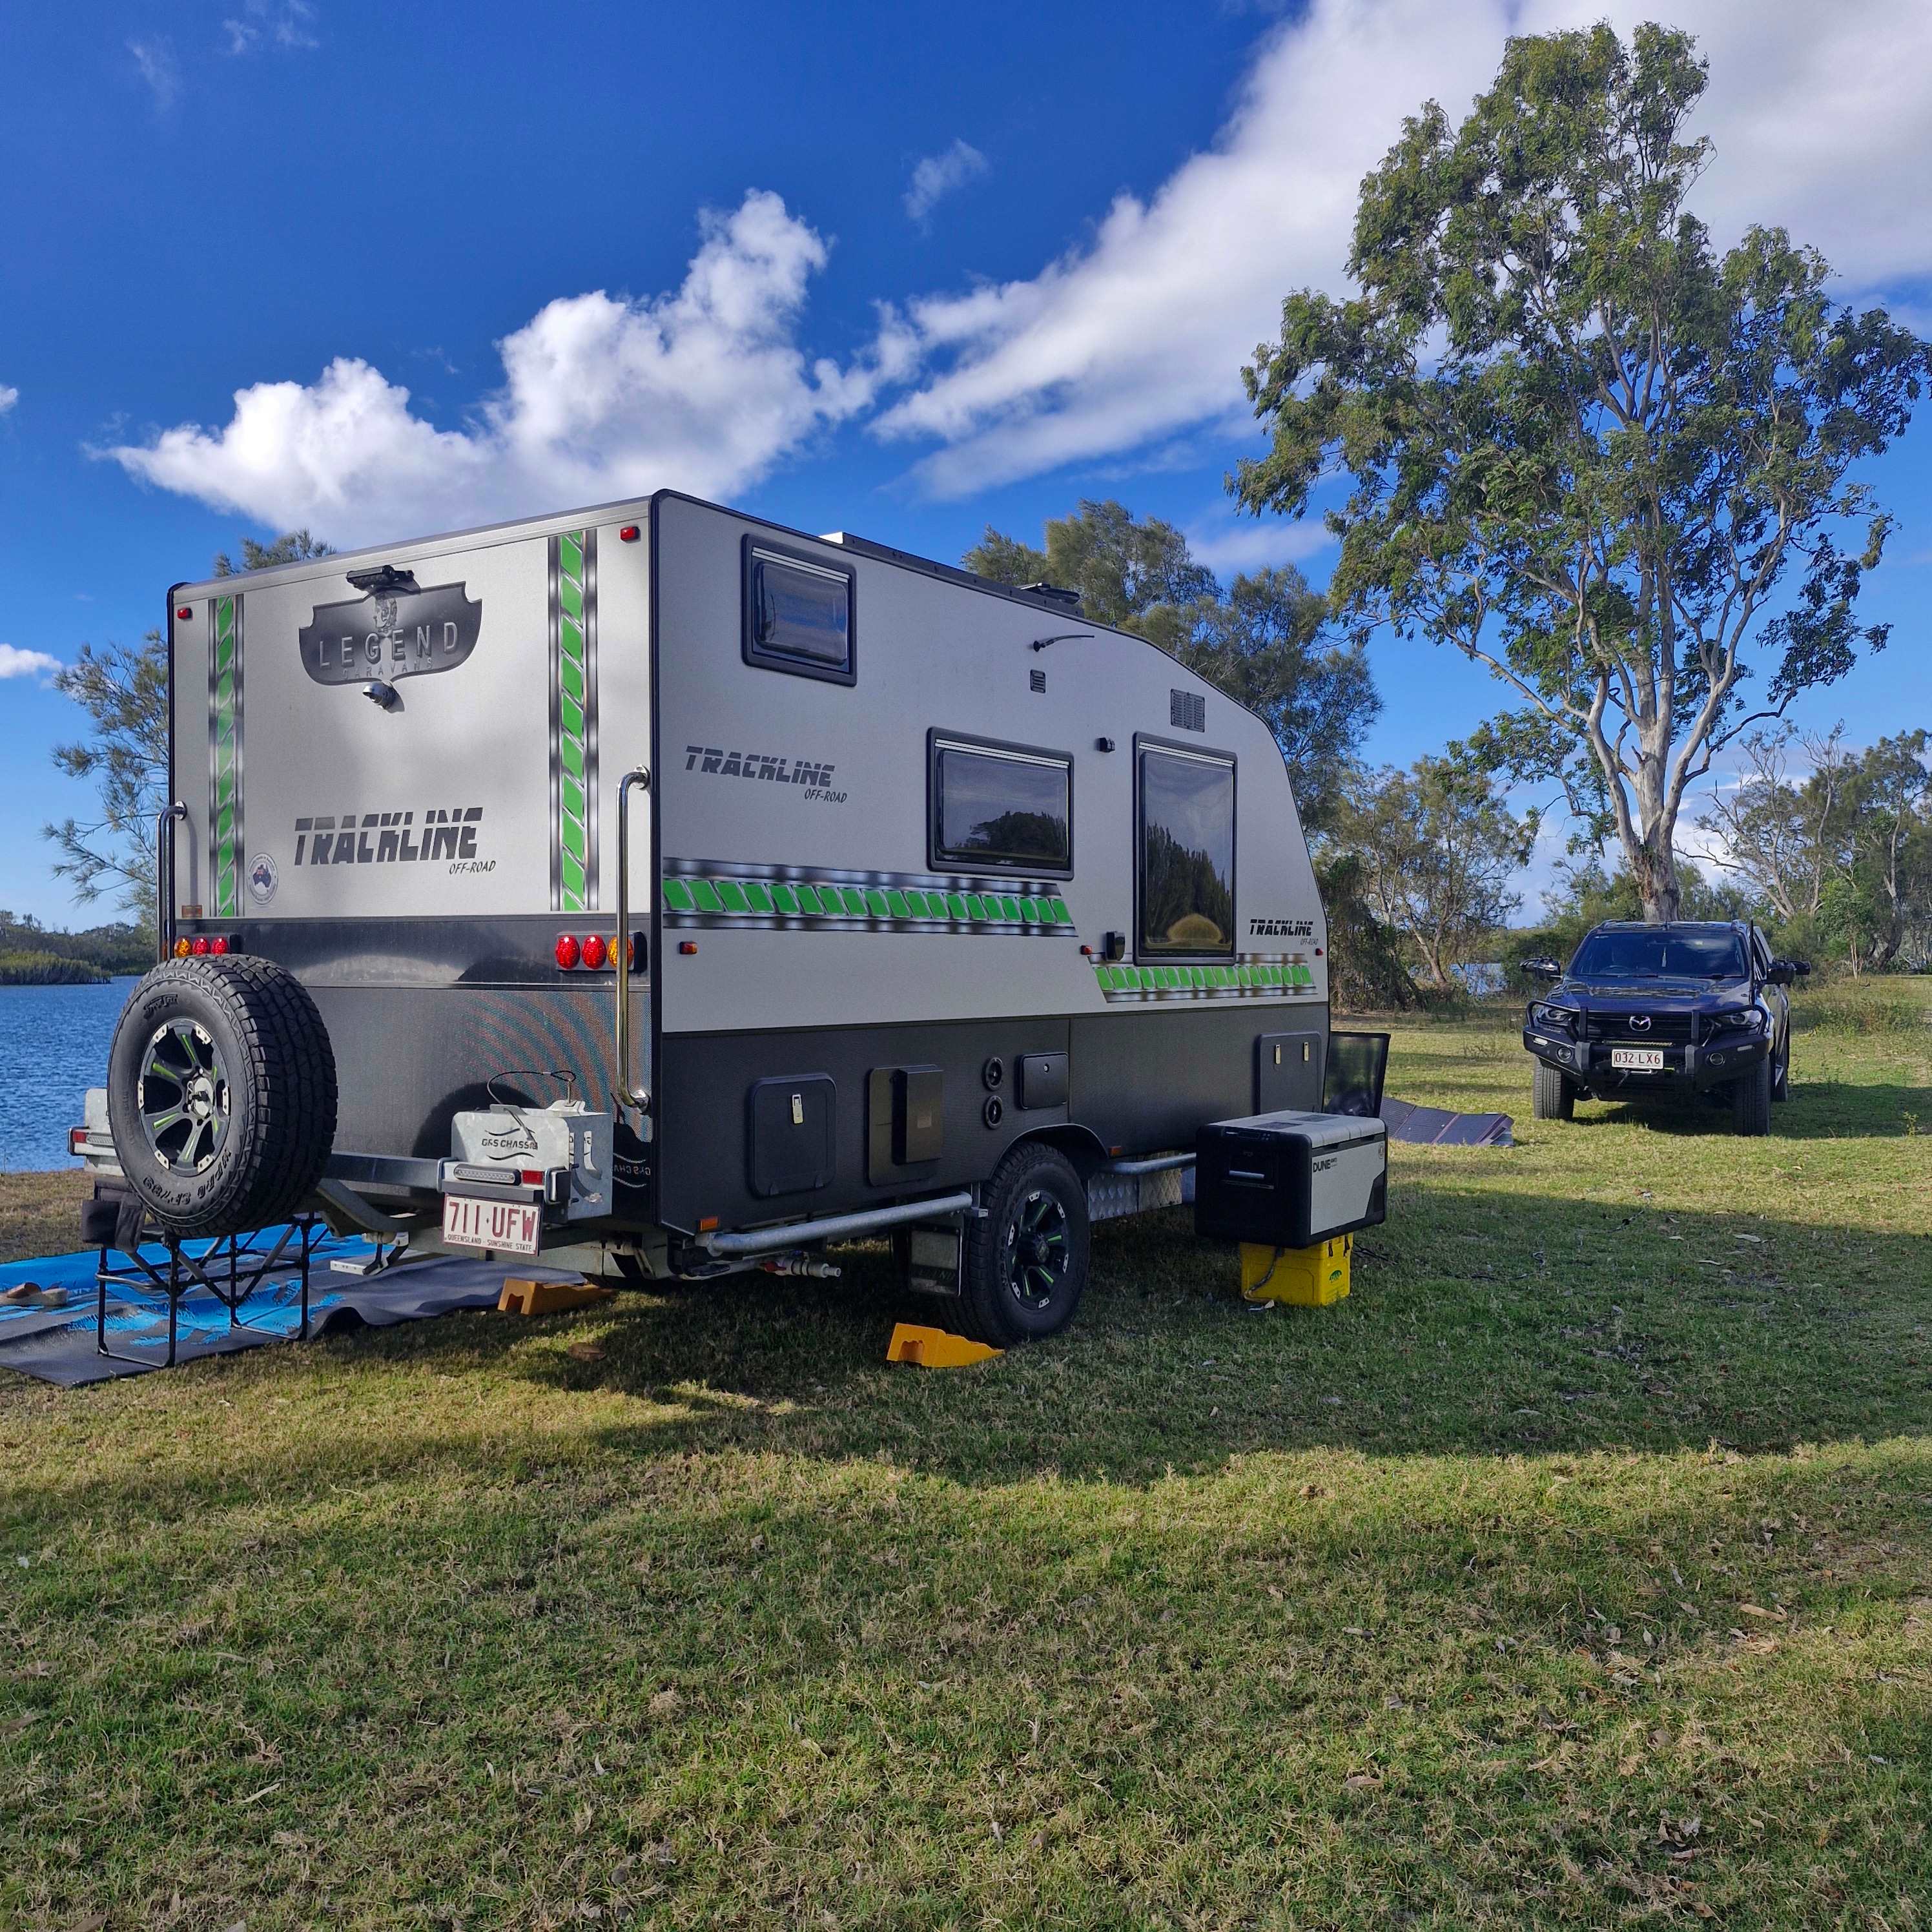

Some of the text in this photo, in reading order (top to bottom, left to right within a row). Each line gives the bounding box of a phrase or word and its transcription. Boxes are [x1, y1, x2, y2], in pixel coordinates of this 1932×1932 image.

[319, 621, 459, 669] LEGEND
[342, 657, 434, 679] CARAVANS
[685, 745, 836, 788] TRACKLINE
[804, 788, 848, 804] OFF-ROAD
[294, 807, 483, 866] TRACKLINE
[449, 859, 497, 875] OFF-ROAD
[1249, 918, 1314, 936] TRACKLINE
[1615, 1053, 1634, 1063] 032
[482, 1138, 499, 1147] G&S
[1313, 1159, 1330, 1173] DUNE
[449, 1201, 537, 1242] 711 UFW
[447, 1234, 533, 1251] QUEENSLAND SUNSHINE STATE
